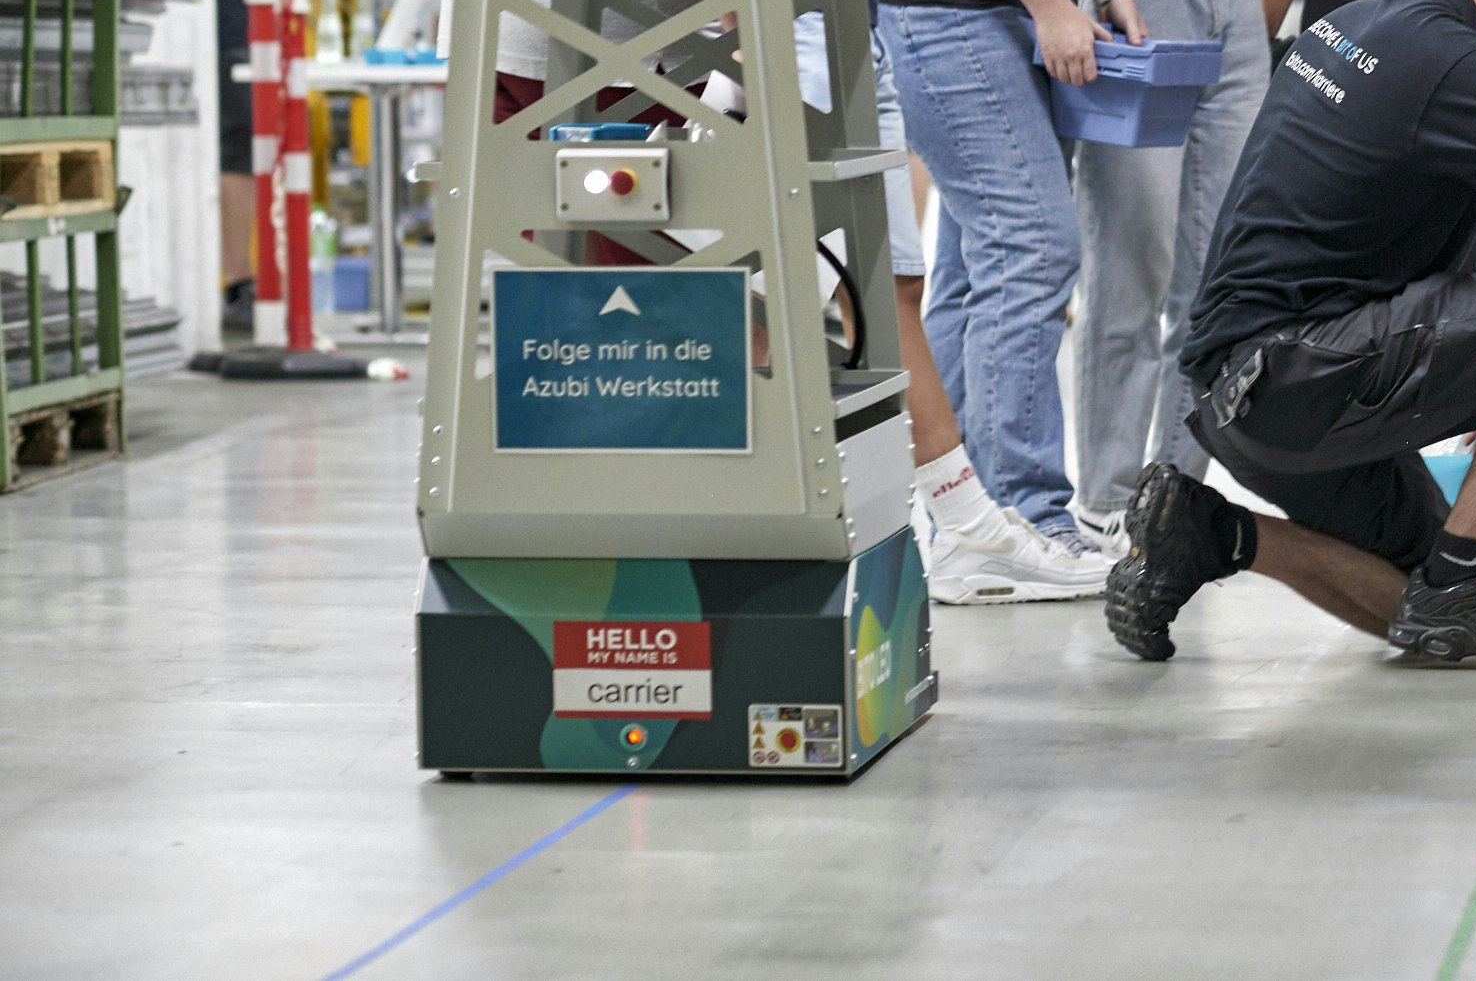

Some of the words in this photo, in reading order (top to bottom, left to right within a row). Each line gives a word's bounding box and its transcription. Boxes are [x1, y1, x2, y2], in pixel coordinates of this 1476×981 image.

[1346, 45, 1364, 63] OF
[1357, 52, 1379, 74] US
[522, 338, 591, 365] Folge
[597, 339, 640, 360] mir
[645, 339, 668, 361] in
[674, 338, 712, 361] die
[522, 375, 590, 397] Azubi
[595, 375, 720, 398] Werkstatt
[586, 628, 678, 650] HELLO
[587, 651, 611, 664] MY
[614, 651, 660, 664] NAME
[663, 651, 678, 665] IS
[587, 678, 684, 704] carrier
